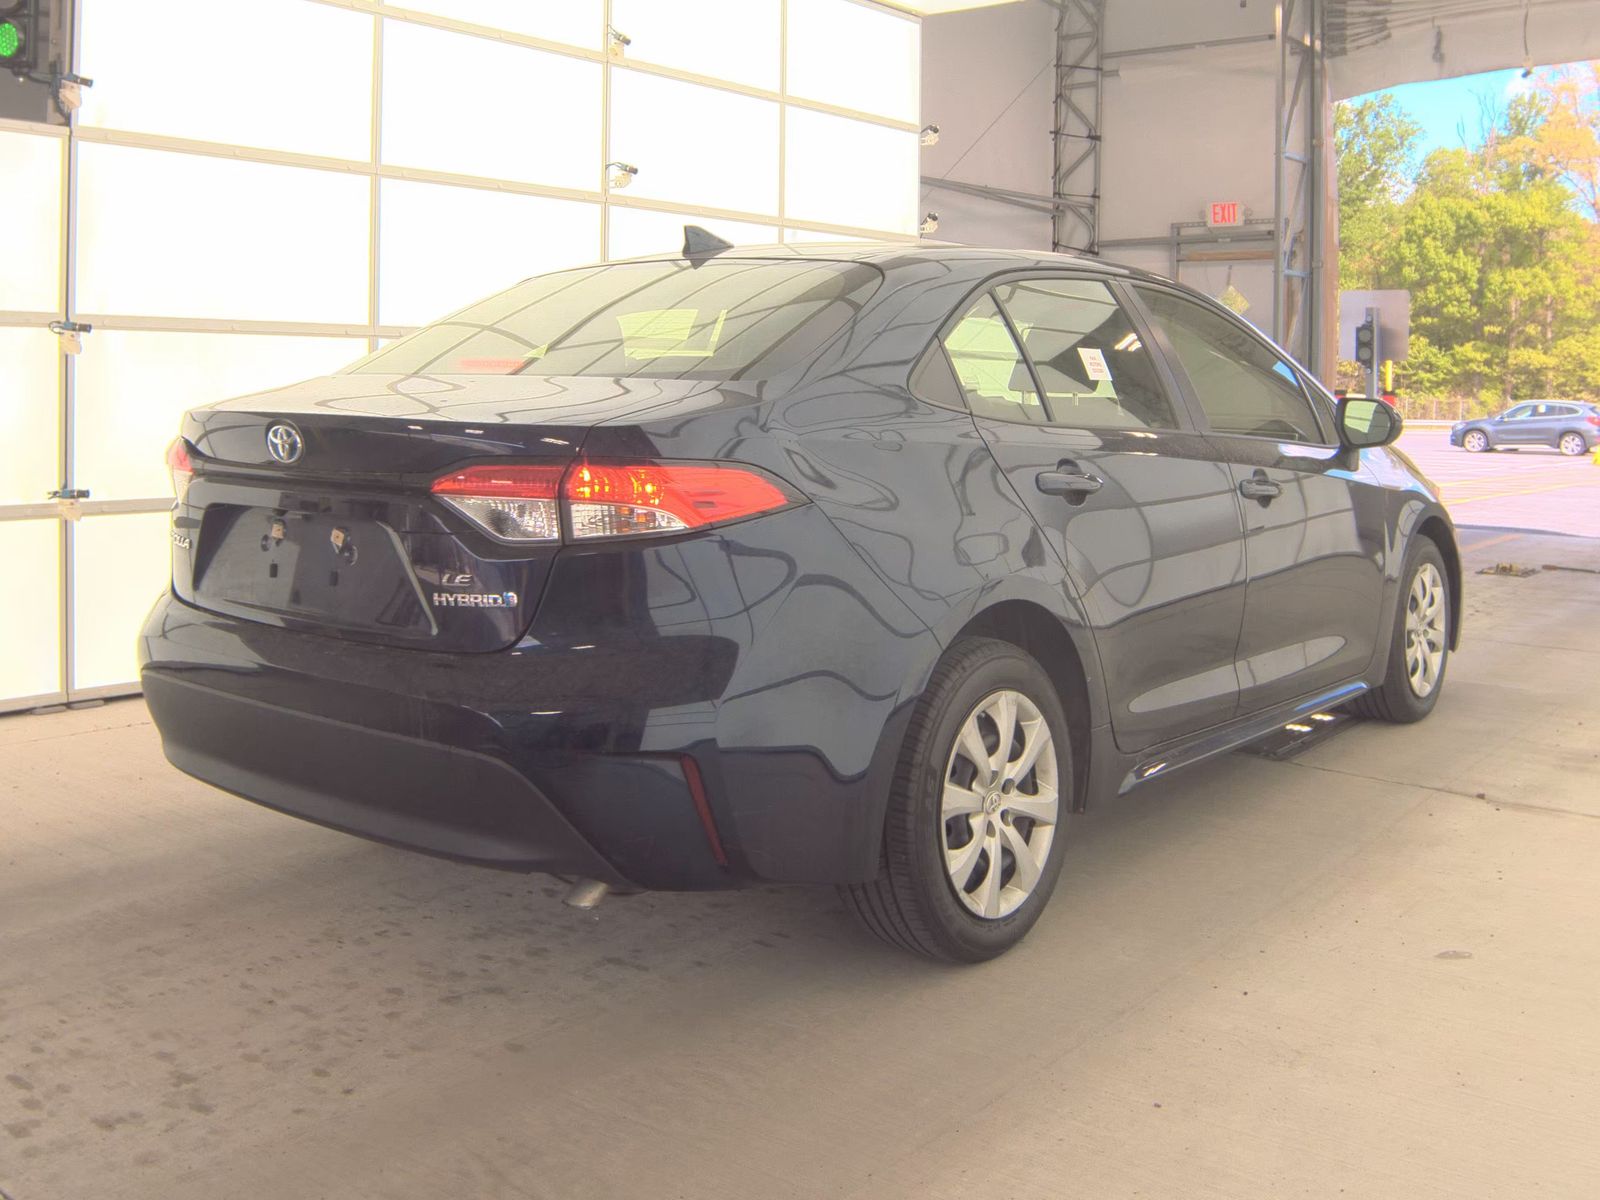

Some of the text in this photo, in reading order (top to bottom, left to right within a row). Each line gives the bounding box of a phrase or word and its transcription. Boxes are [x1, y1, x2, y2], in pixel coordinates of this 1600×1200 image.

[1212, 203, 1237, 224] EXIT
[442, 574, 472, 587] LE
[433, 592, 503, 608] HYBRID
